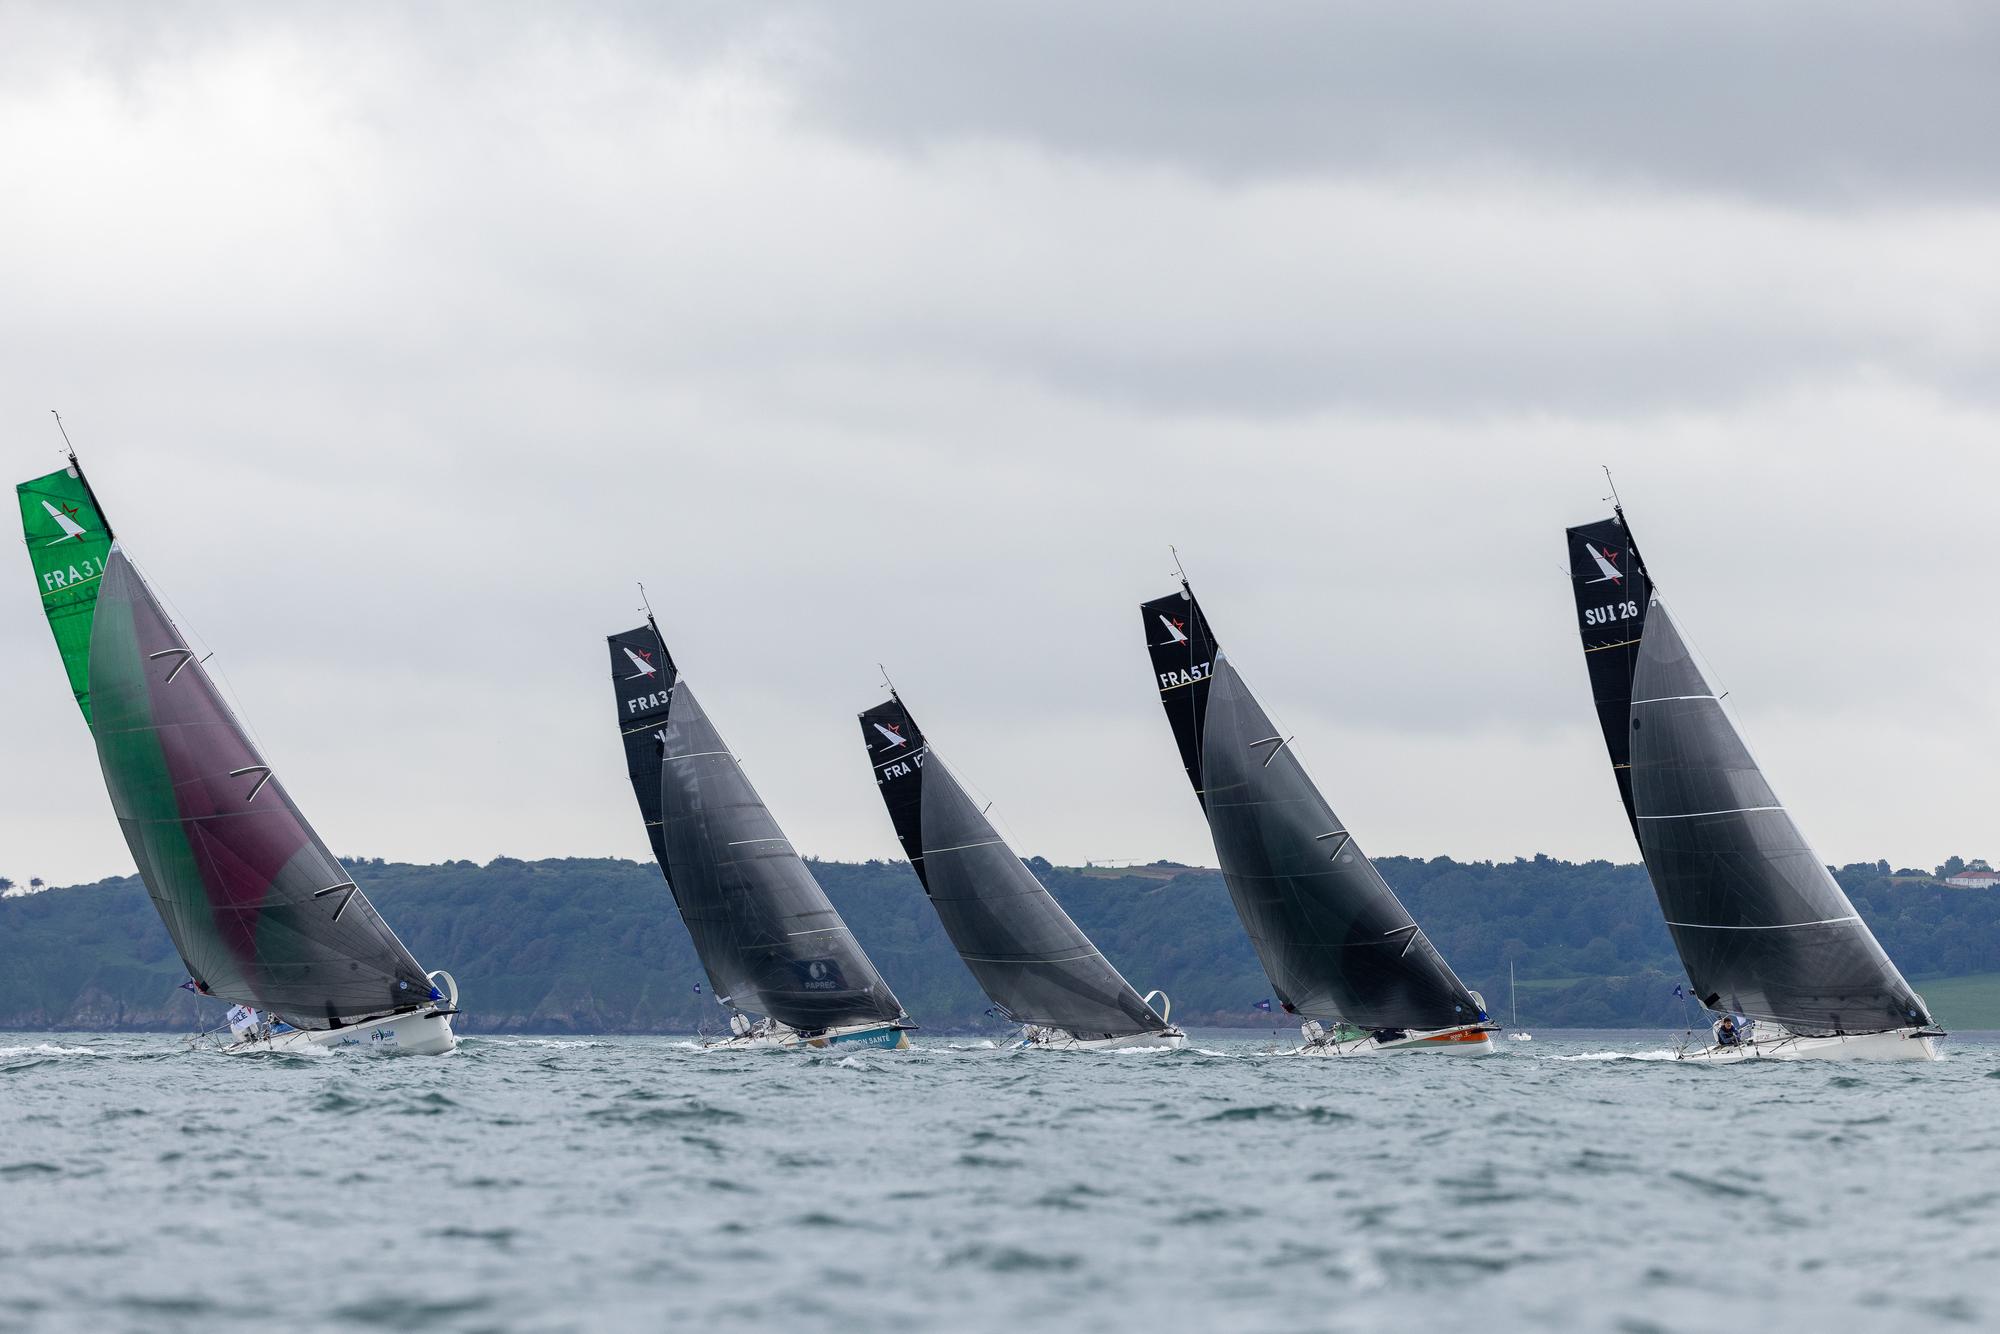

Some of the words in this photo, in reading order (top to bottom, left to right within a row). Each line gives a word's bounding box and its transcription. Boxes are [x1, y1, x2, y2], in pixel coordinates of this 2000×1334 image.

[1585, 604, 1617, 626] SUI
[1618, 600, 1638, 619] 26
[1159, 662, 1210, 688] FRA57
[883, 762, 912, 781] FRA
[804, 981, 837, 989] PAPREC
